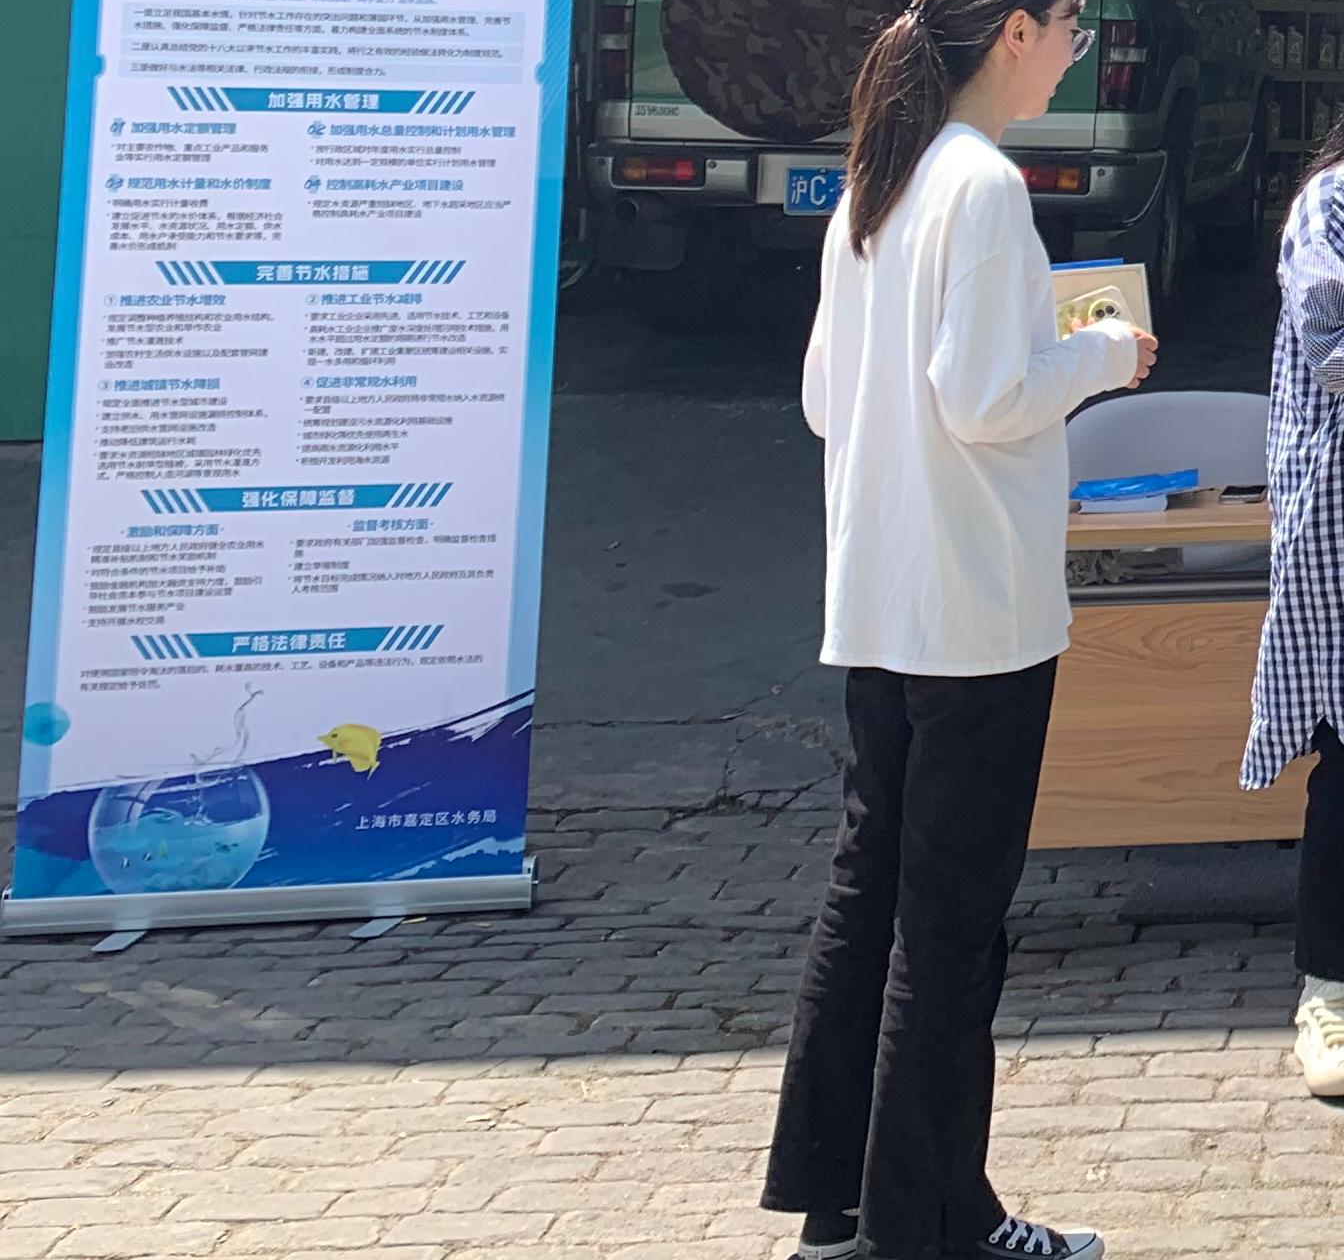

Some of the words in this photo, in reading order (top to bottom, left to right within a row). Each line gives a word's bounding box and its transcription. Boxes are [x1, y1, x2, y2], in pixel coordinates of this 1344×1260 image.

[267, 92, 380, 110] 加强用水管理
[256, 265, 370, 282] 完善节水措施
[242, 489, 355, 508] 强化保障监督
[231, 632, 347, 653] 严格法律责任
[354, 808, 498, 831] 上海市嘉定区水务局
